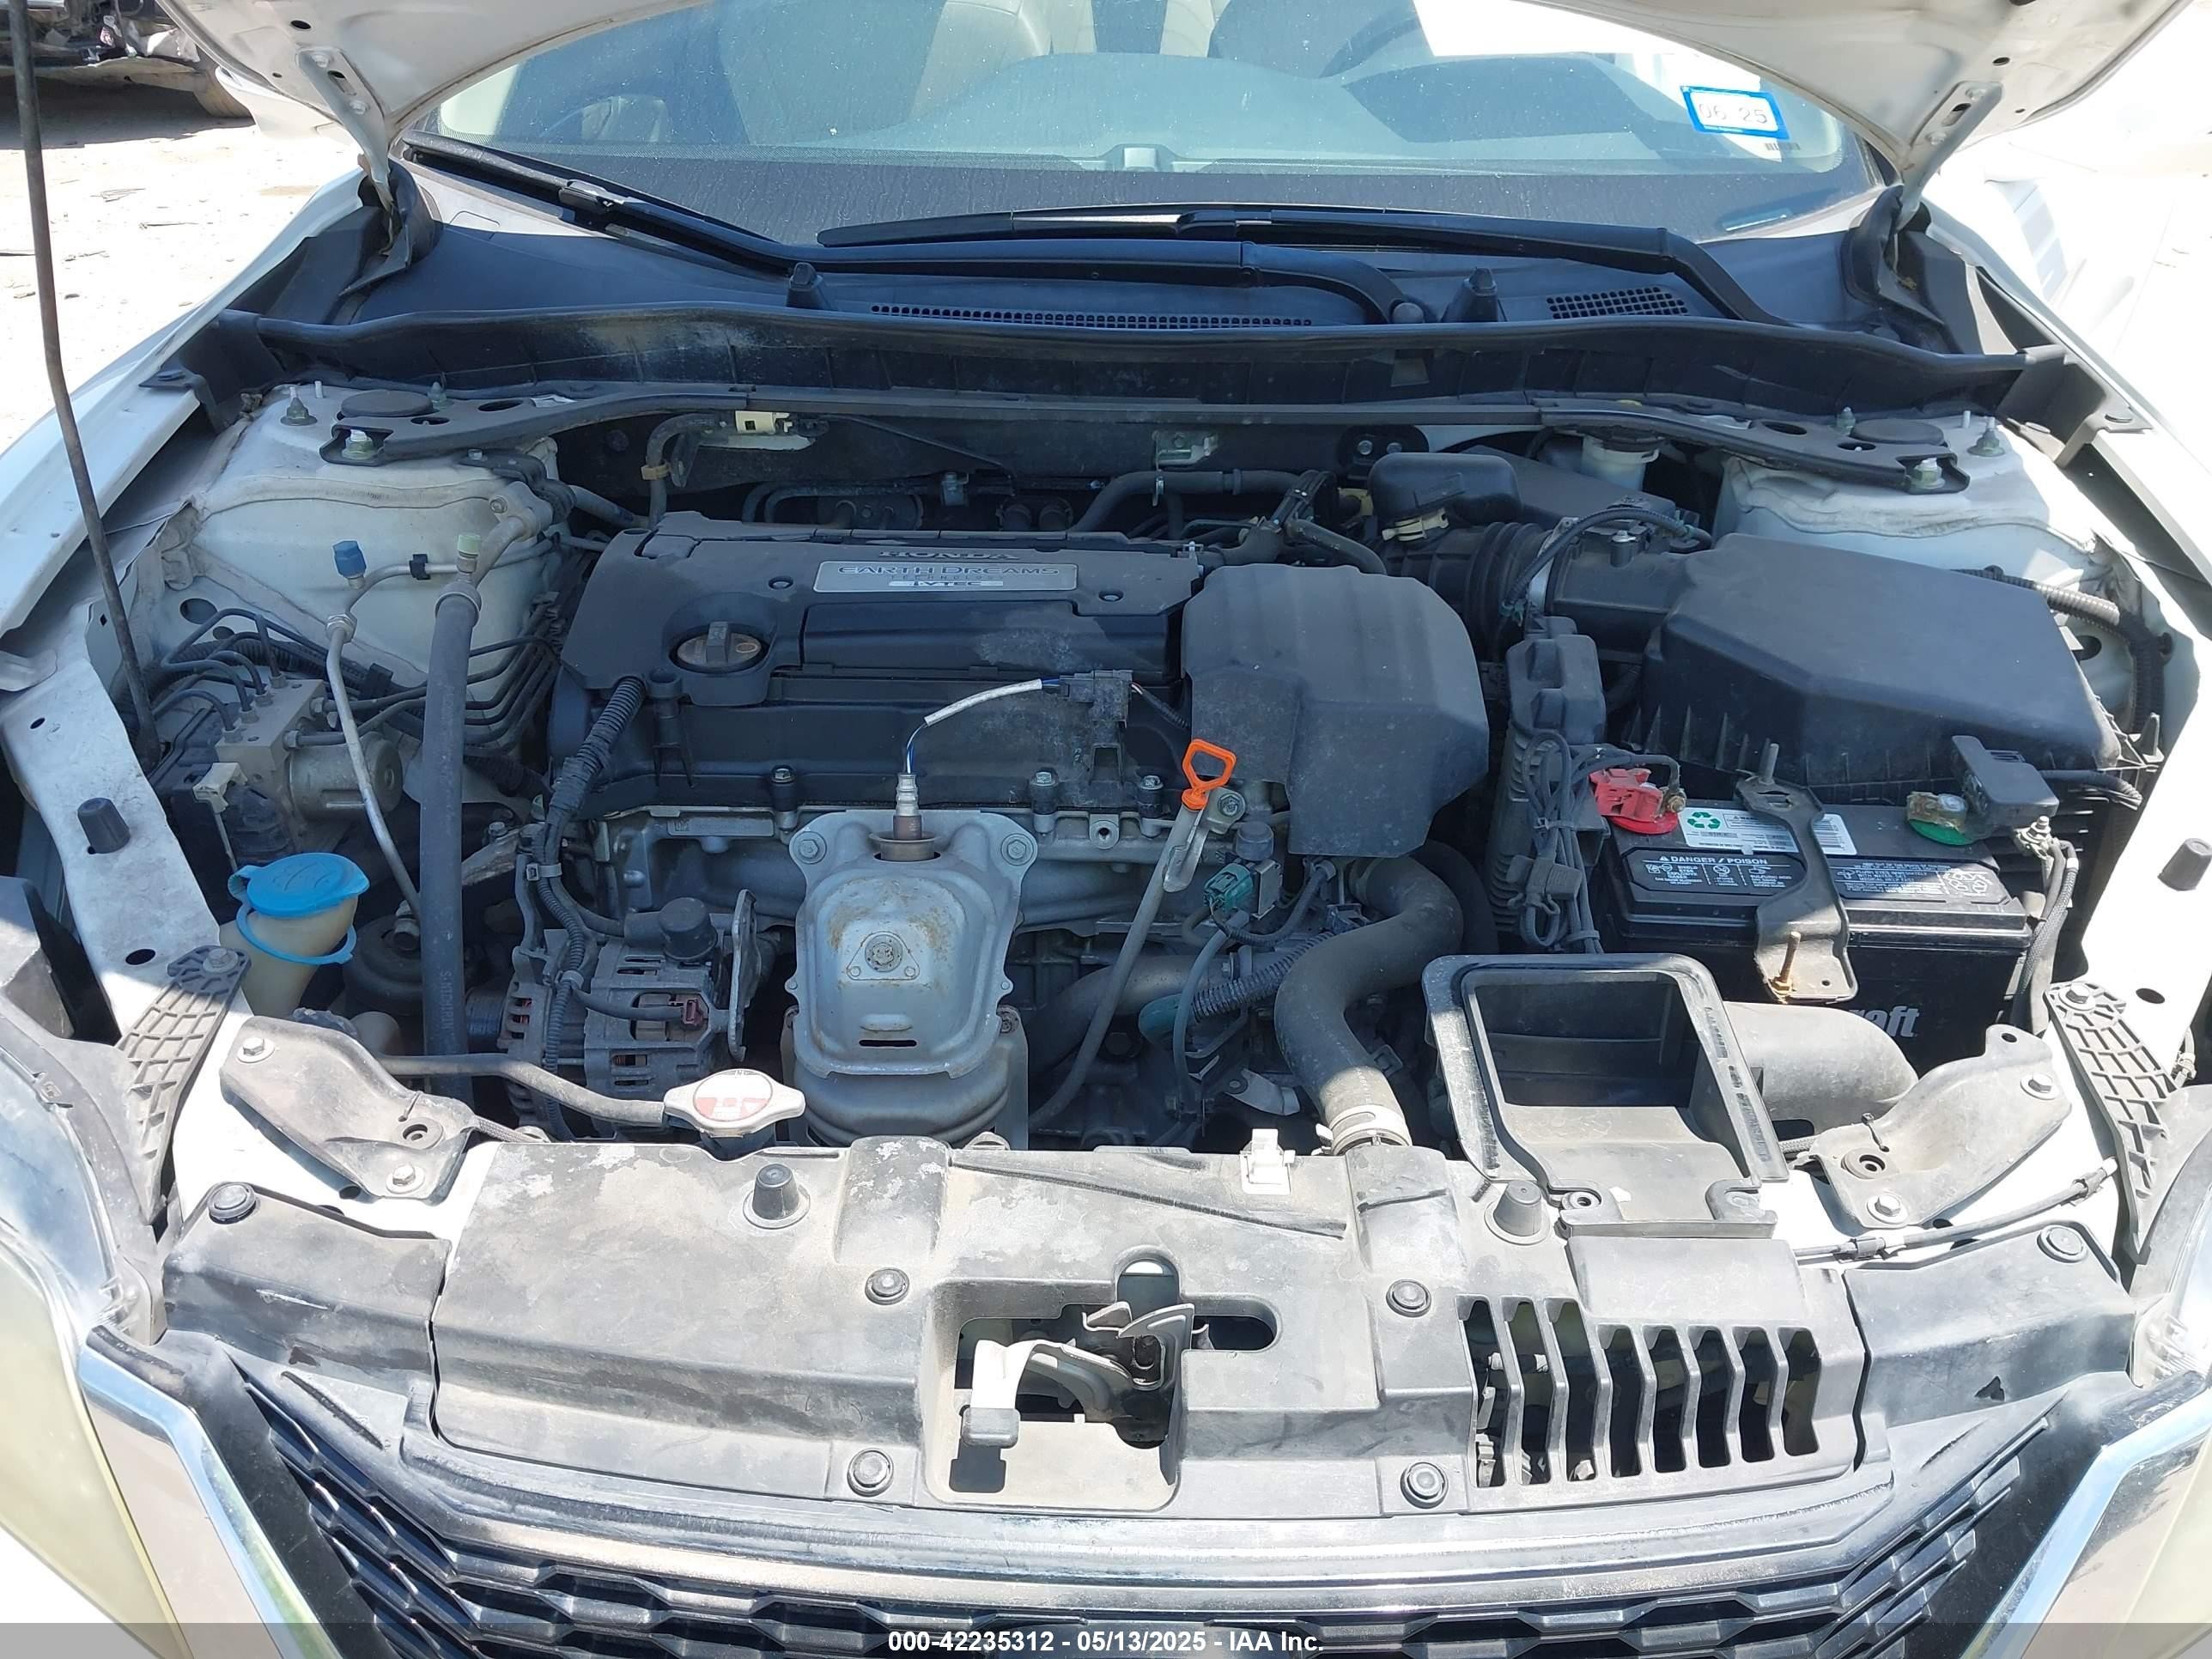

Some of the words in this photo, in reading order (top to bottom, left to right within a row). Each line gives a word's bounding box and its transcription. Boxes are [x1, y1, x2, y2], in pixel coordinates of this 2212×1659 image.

[1738, 107, 1768, 124] 25
[879, 551, 1019, 560] HONDA
[838, 566, 934, 574] EARTH
[941, 566, 1060, 575] DREAMS
